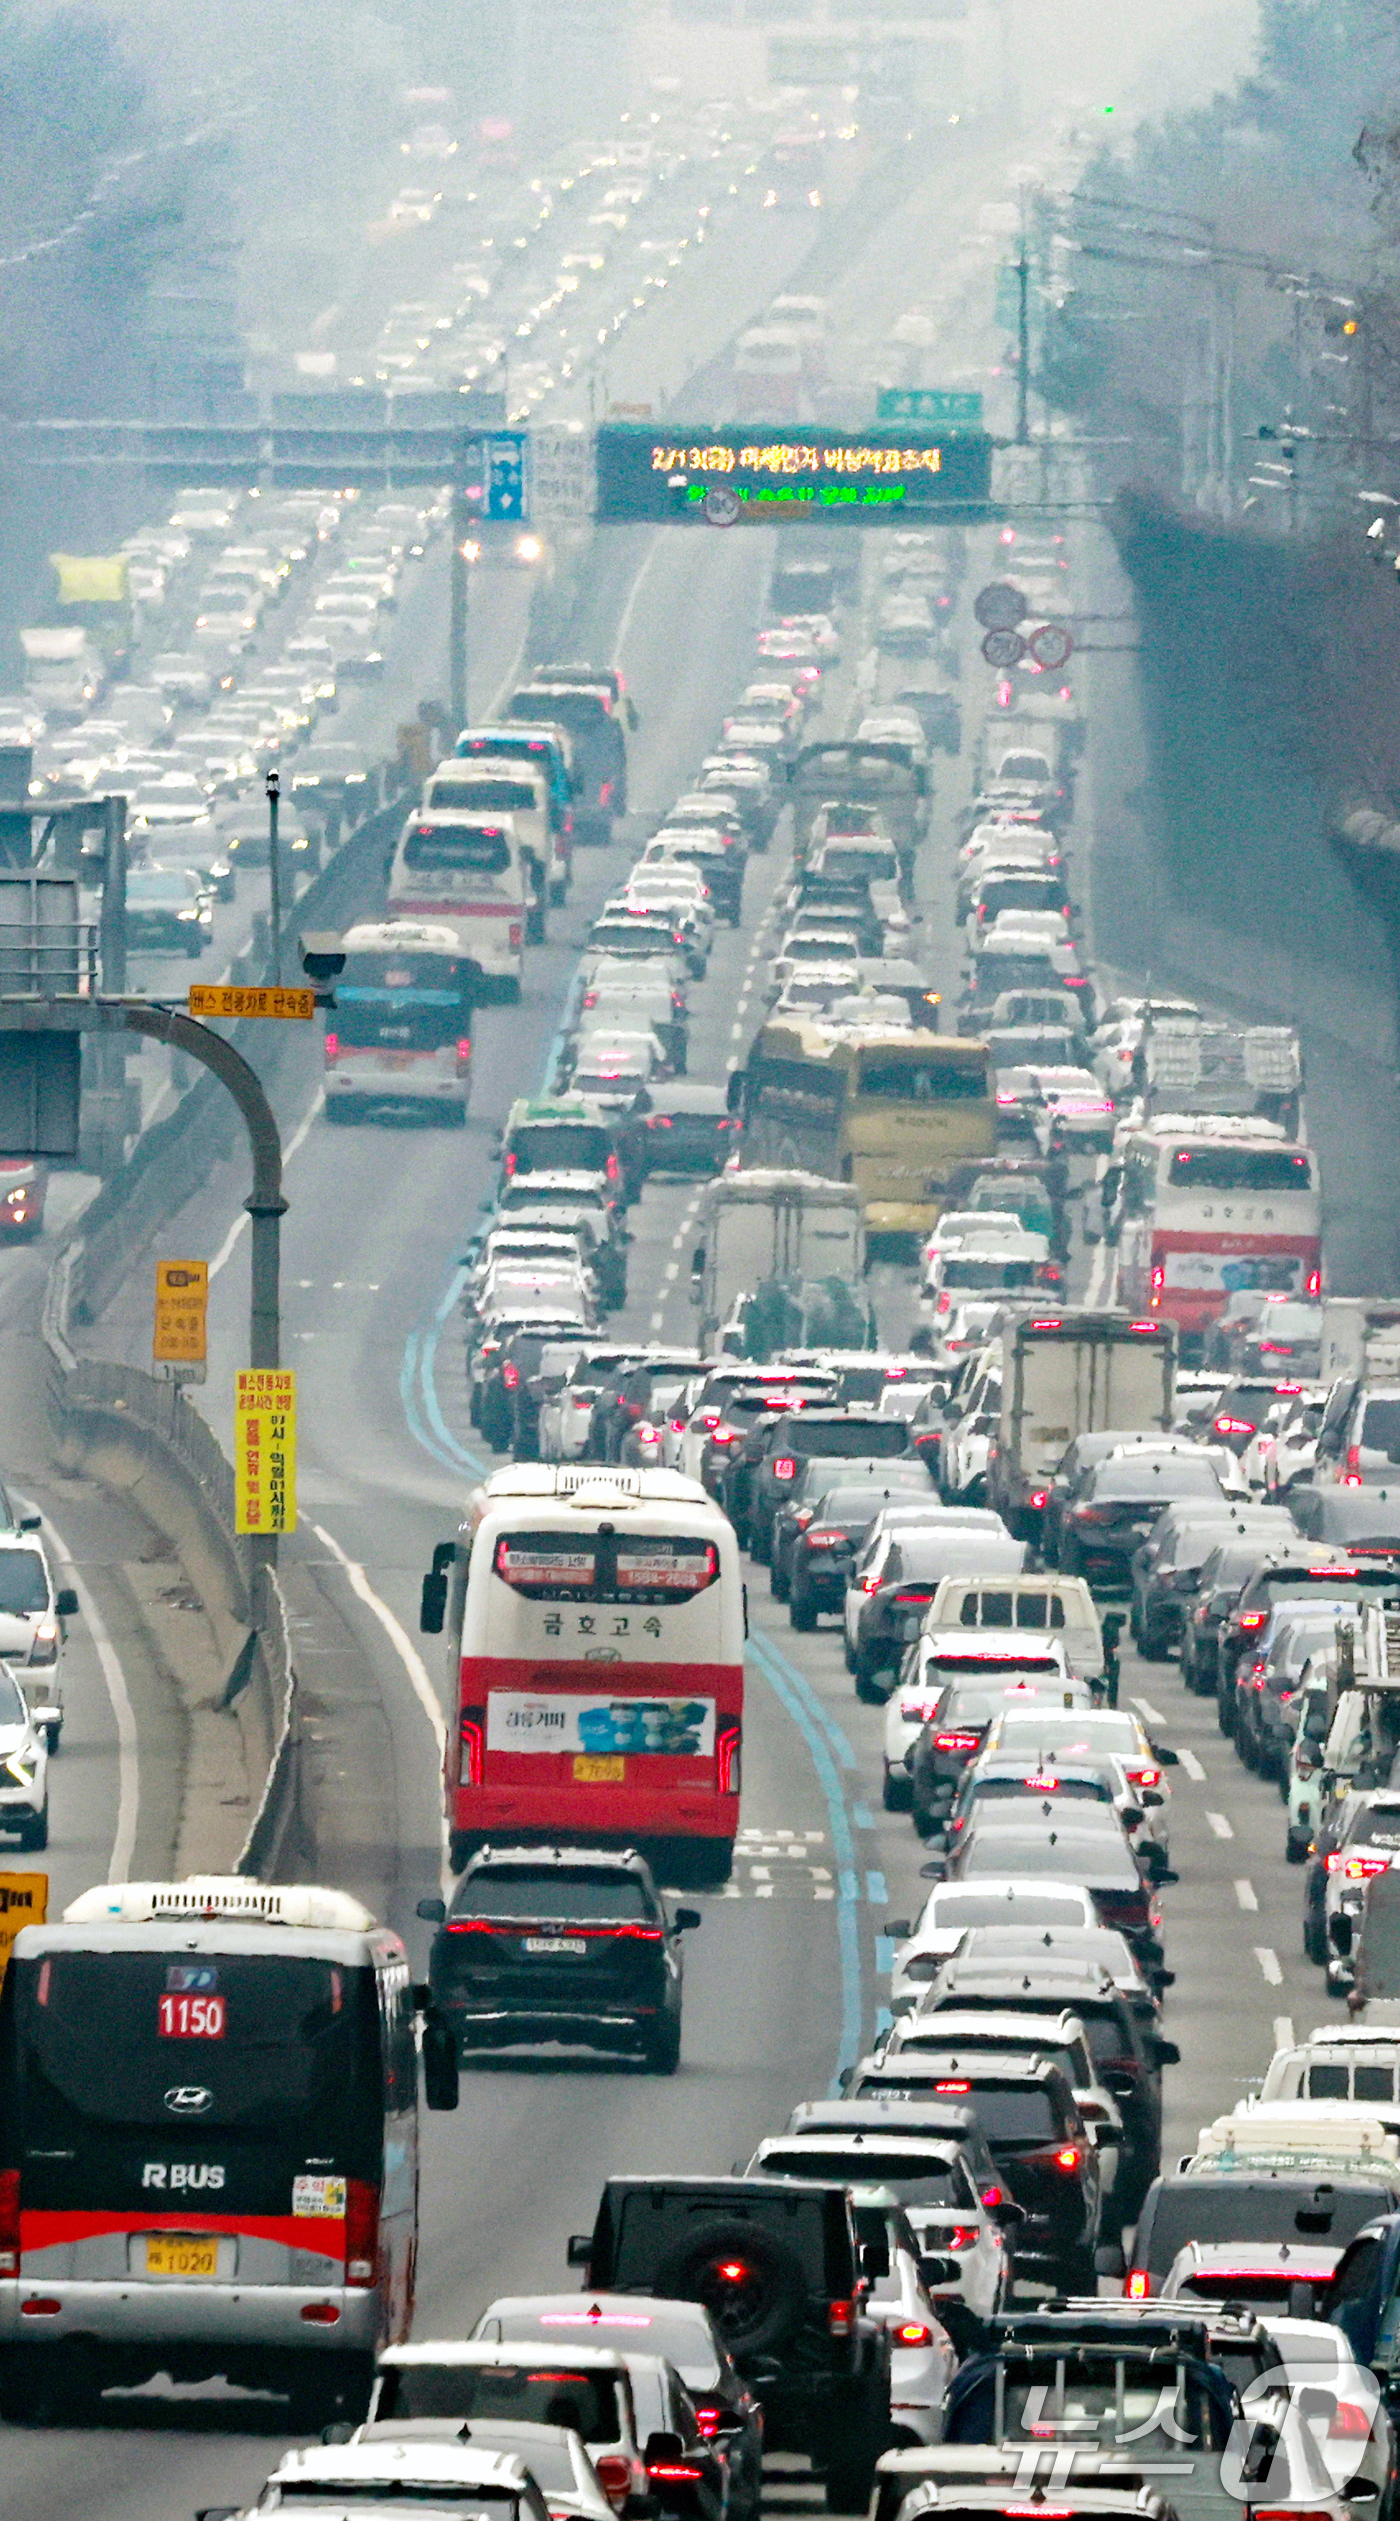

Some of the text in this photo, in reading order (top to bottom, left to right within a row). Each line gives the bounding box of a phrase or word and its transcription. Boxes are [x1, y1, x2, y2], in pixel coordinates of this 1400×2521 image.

[543, 1613, 661, 1638] 금호고속
[161, 1998, 222, 2035] 1150
[168, 2253, 212, 2273] 1020
